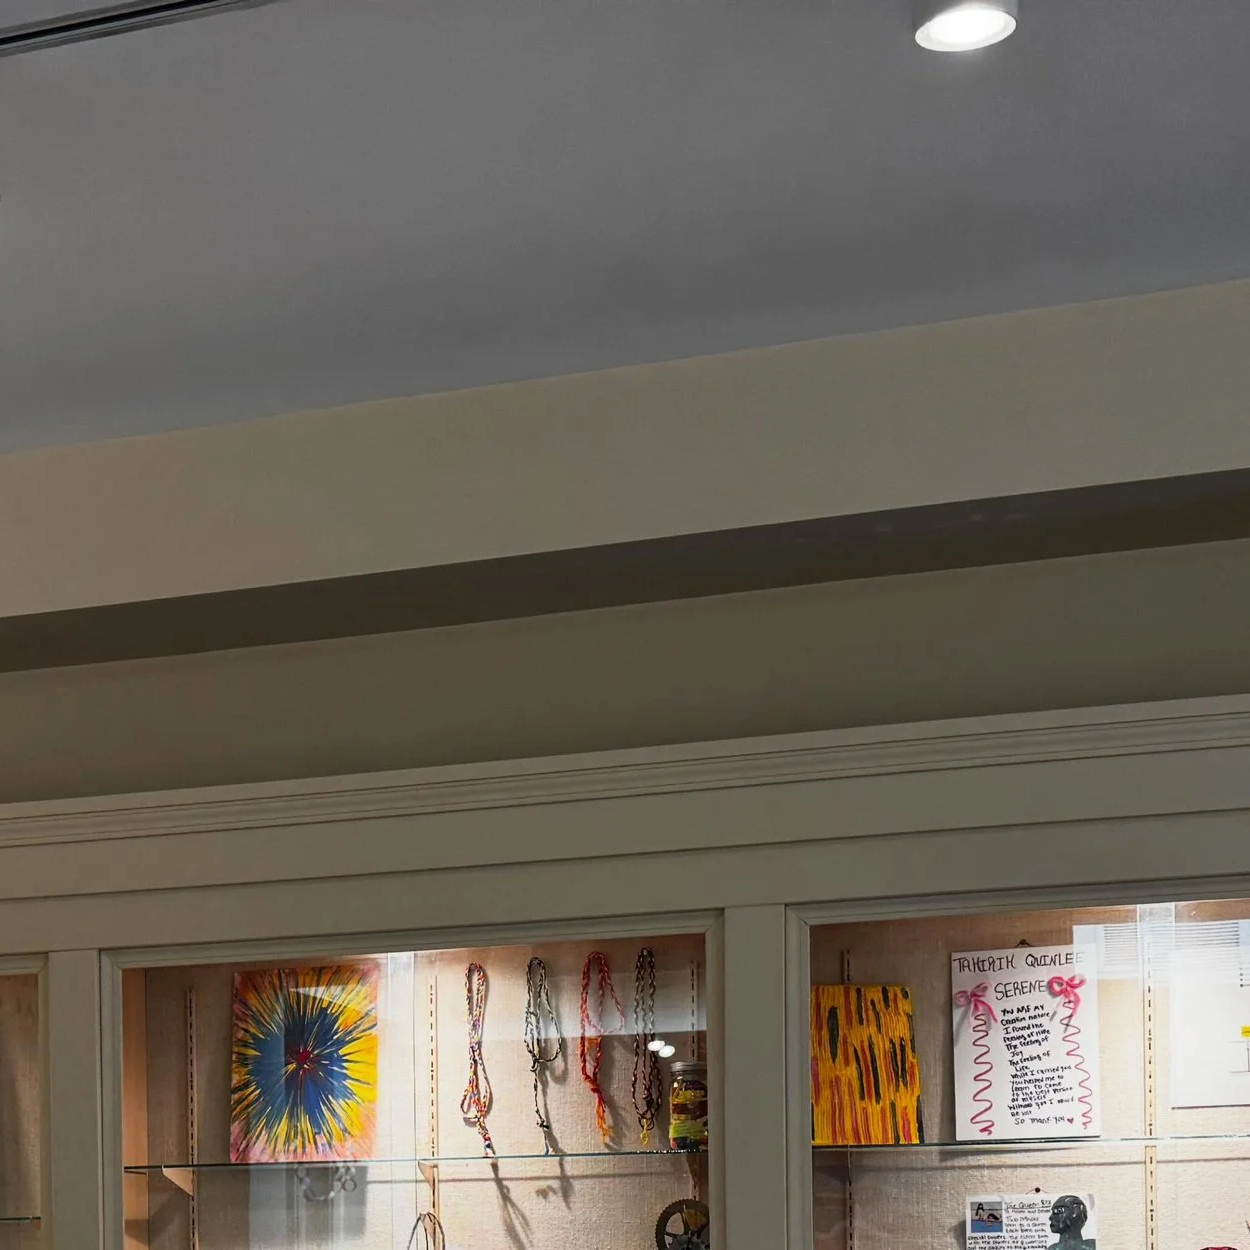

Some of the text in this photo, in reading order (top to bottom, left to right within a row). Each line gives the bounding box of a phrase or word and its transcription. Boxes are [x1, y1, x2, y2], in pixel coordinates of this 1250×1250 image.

[953, 951, 1085, 973] TAHIRIH QUINLEE
[994, 980, 1048, 1001] SERENE
[1003, 1027, 1012, 1035] I
[1009, 1049, 1024, 1058] Joy
[1014, 1117, 1026, 1126] So
